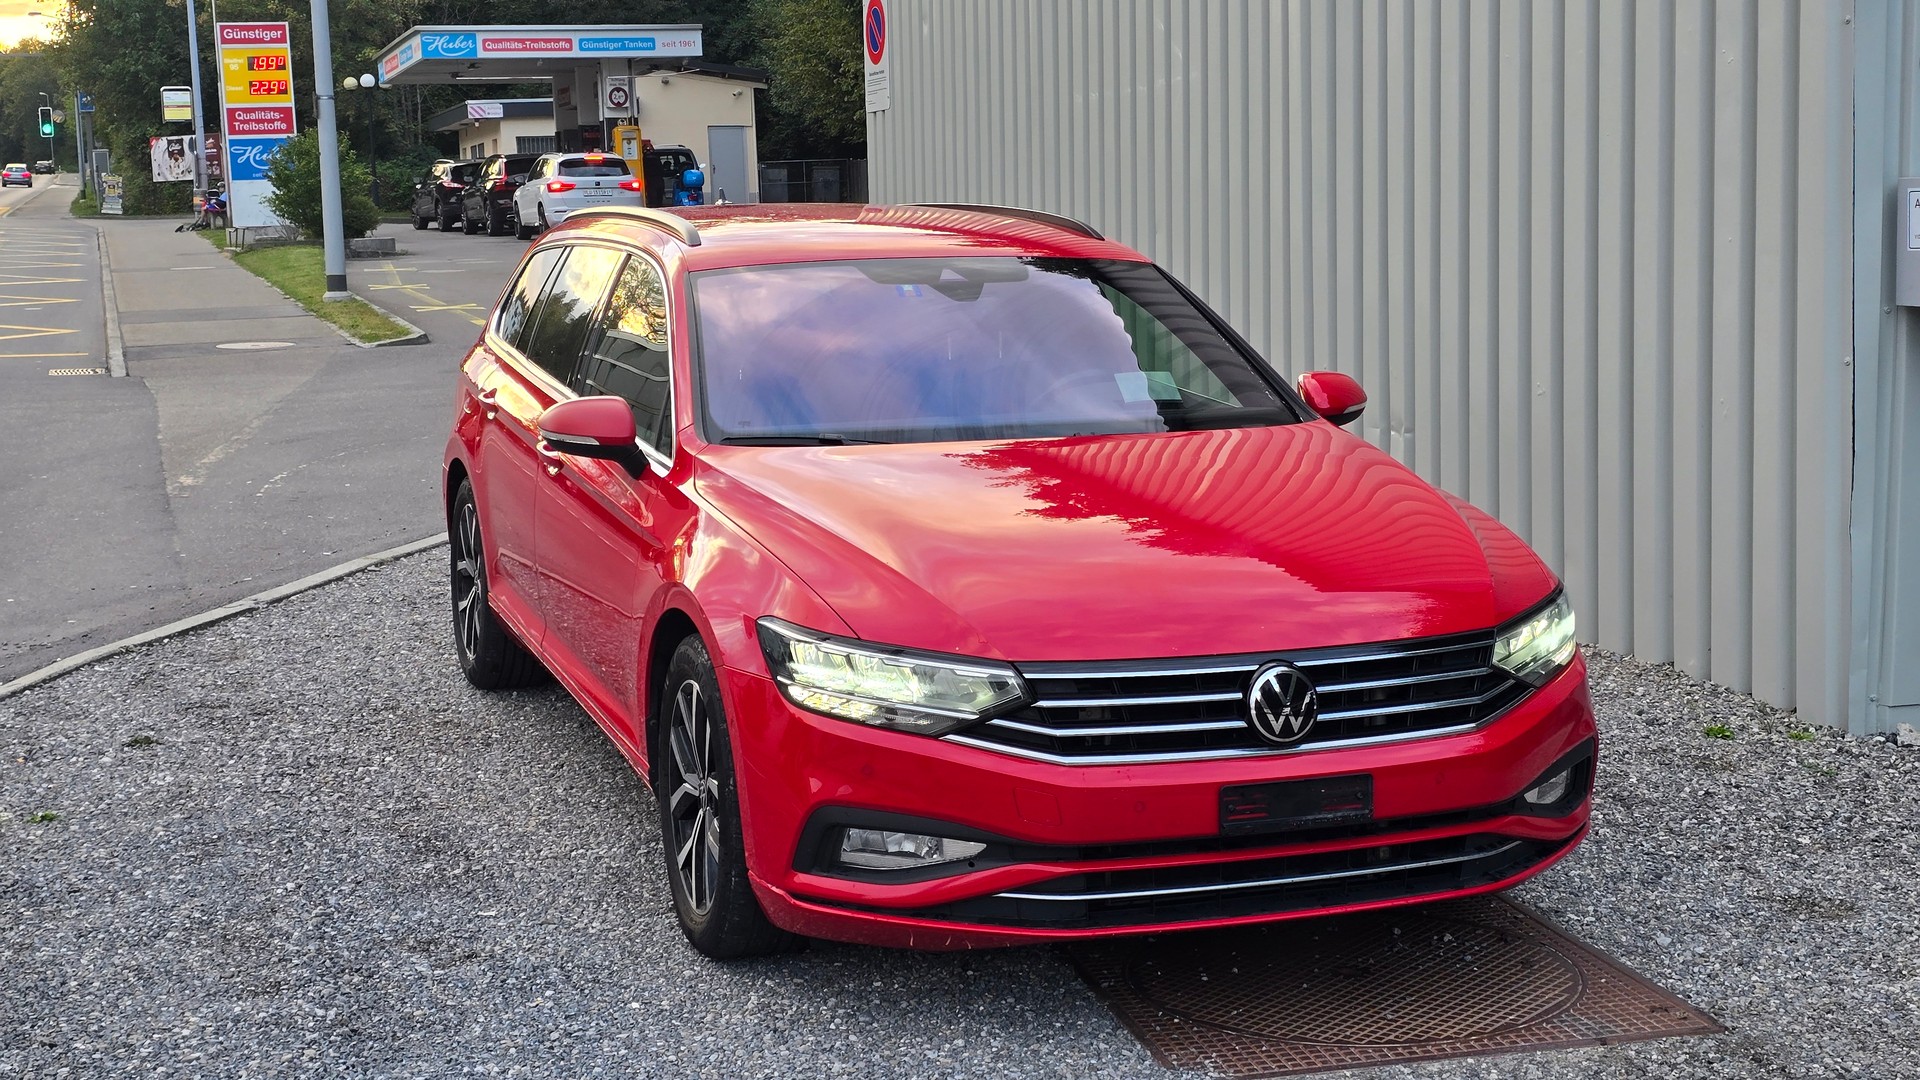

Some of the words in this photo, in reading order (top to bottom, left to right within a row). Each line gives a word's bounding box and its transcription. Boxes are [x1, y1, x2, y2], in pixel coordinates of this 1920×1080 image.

[223, 28, 283, 41] Günstiger
[422, 35, 475, 56] Huber
[485, 41, 570, 49] Qualitäts-Treibstoffe
[581, 41, 622, 50] Günstiger
[624, 40, 653, 48] Tanken
[679, 40, 696, 48] 1961
[235, 110, 284, 121] Qualitäts-
[233, 121, 287, 131] Treibstoffe
